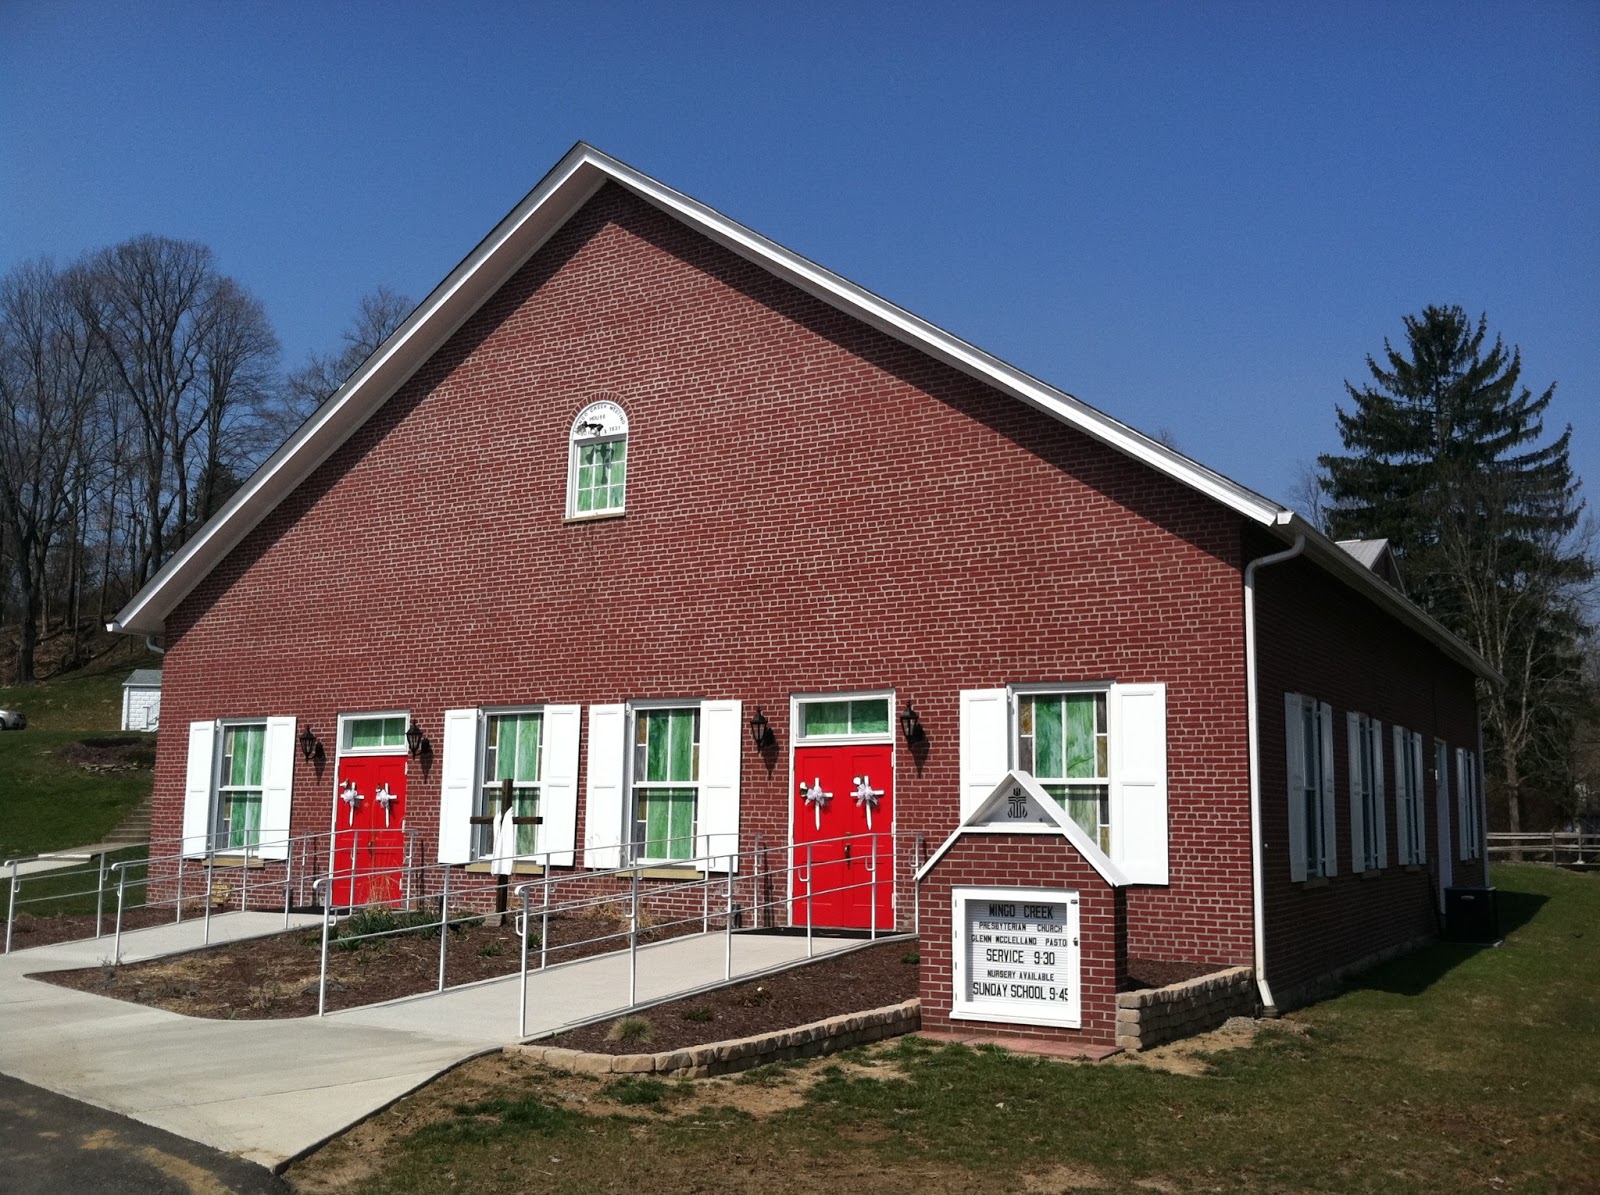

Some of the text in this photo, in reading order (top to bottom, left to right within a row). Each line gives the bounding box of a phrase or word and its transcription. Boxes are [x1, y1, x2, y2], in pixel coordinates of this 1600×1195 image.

[589, 404, 607, 413] CREEK
[589, 414, 606, 422] HOUSE
[989, 903, 1054, 920] MINGO CREEK
[978, 921, 1063, 933] PRESBYTERIAN CHURCH
[970, 934, 1067, 947] GLENN MCCLELLAND PASTO
[986, 948, 1024, 964] SERVICE
[987, 970, 1055, 982] NURSERY AVAILABLE
[972, 982, 1008, 997] SUNDAY
[1010, 984, 1046, 1000] SCHOOL
